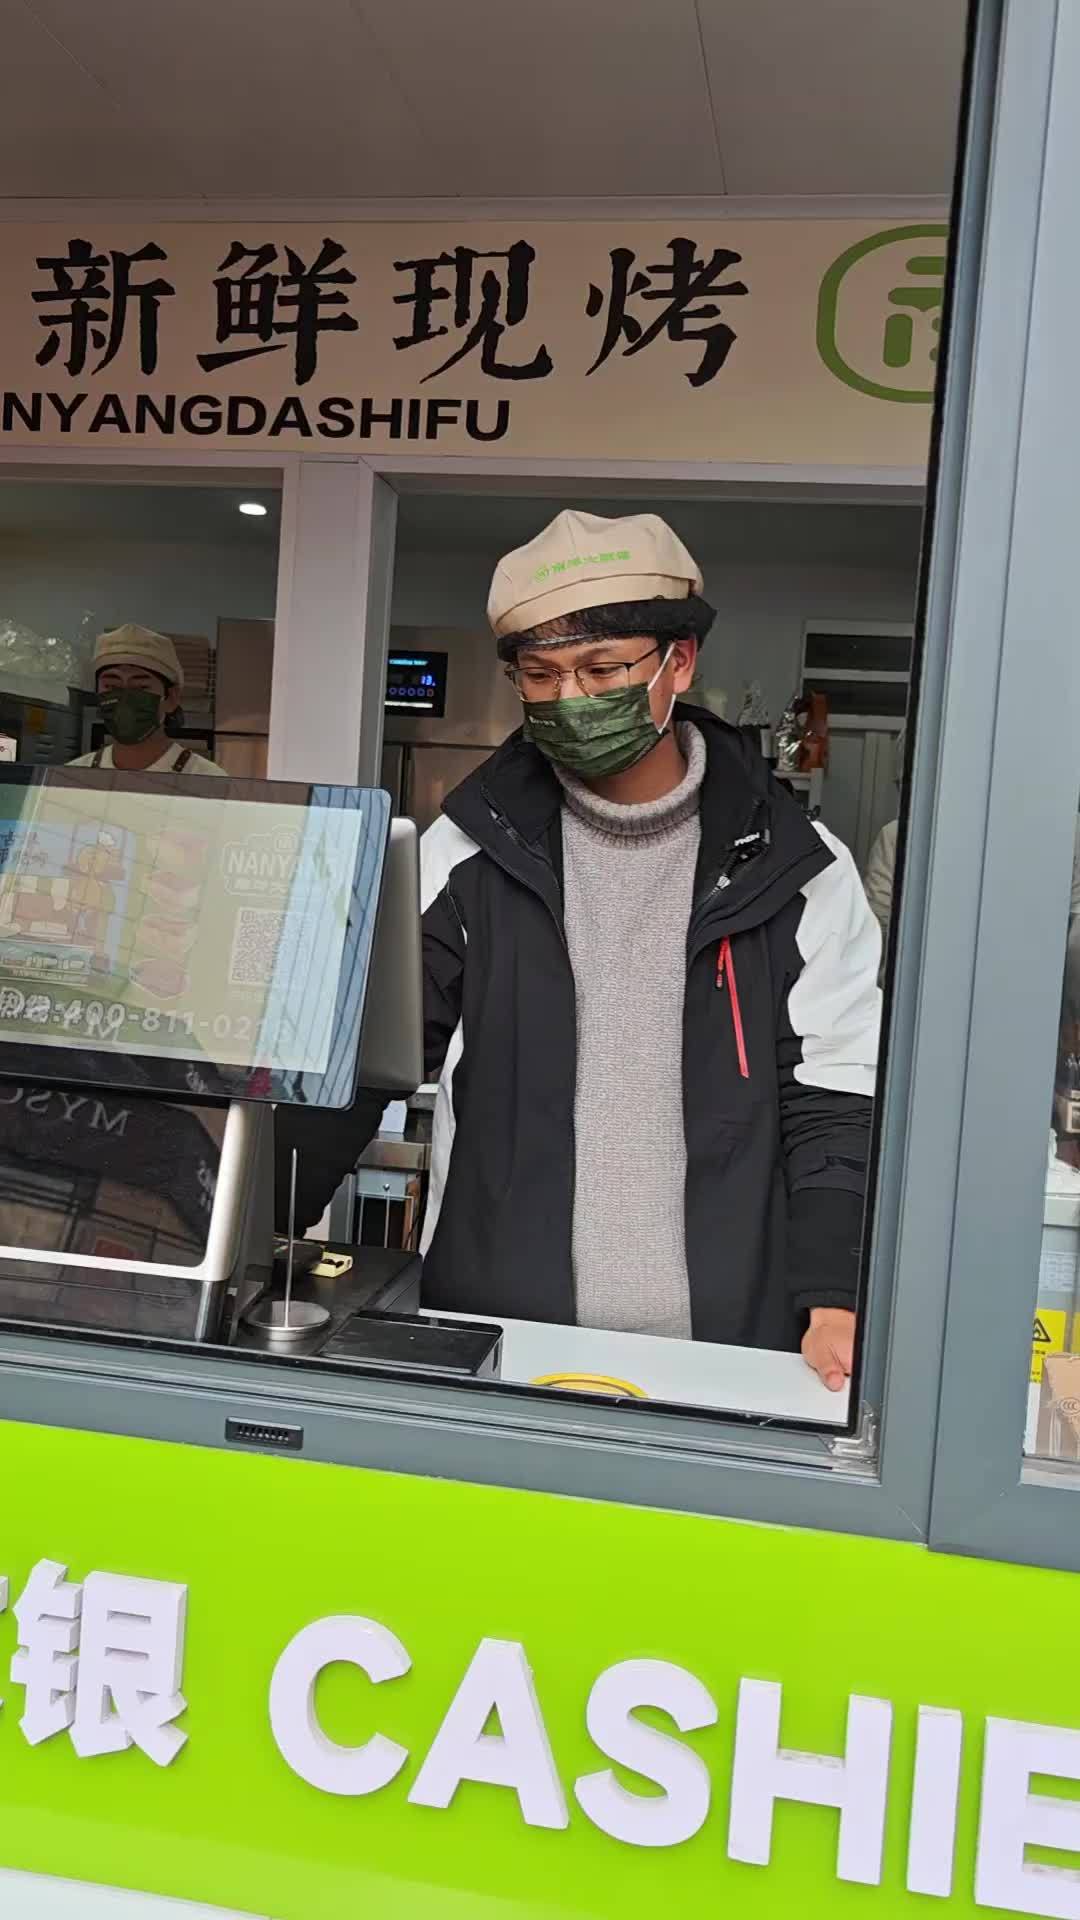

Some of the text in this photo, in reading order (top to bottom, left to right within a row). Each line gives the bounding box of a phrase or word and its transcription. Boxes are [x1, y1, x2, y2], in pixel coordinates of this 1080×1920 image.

[31, 237, 749, 388] 新鲜现烤
[2, 391, 511, 442] NYANGDASHIFU
[0, 1557, 189, 1768] 银
[268, 1613, 1080, 1920] CASHIE
